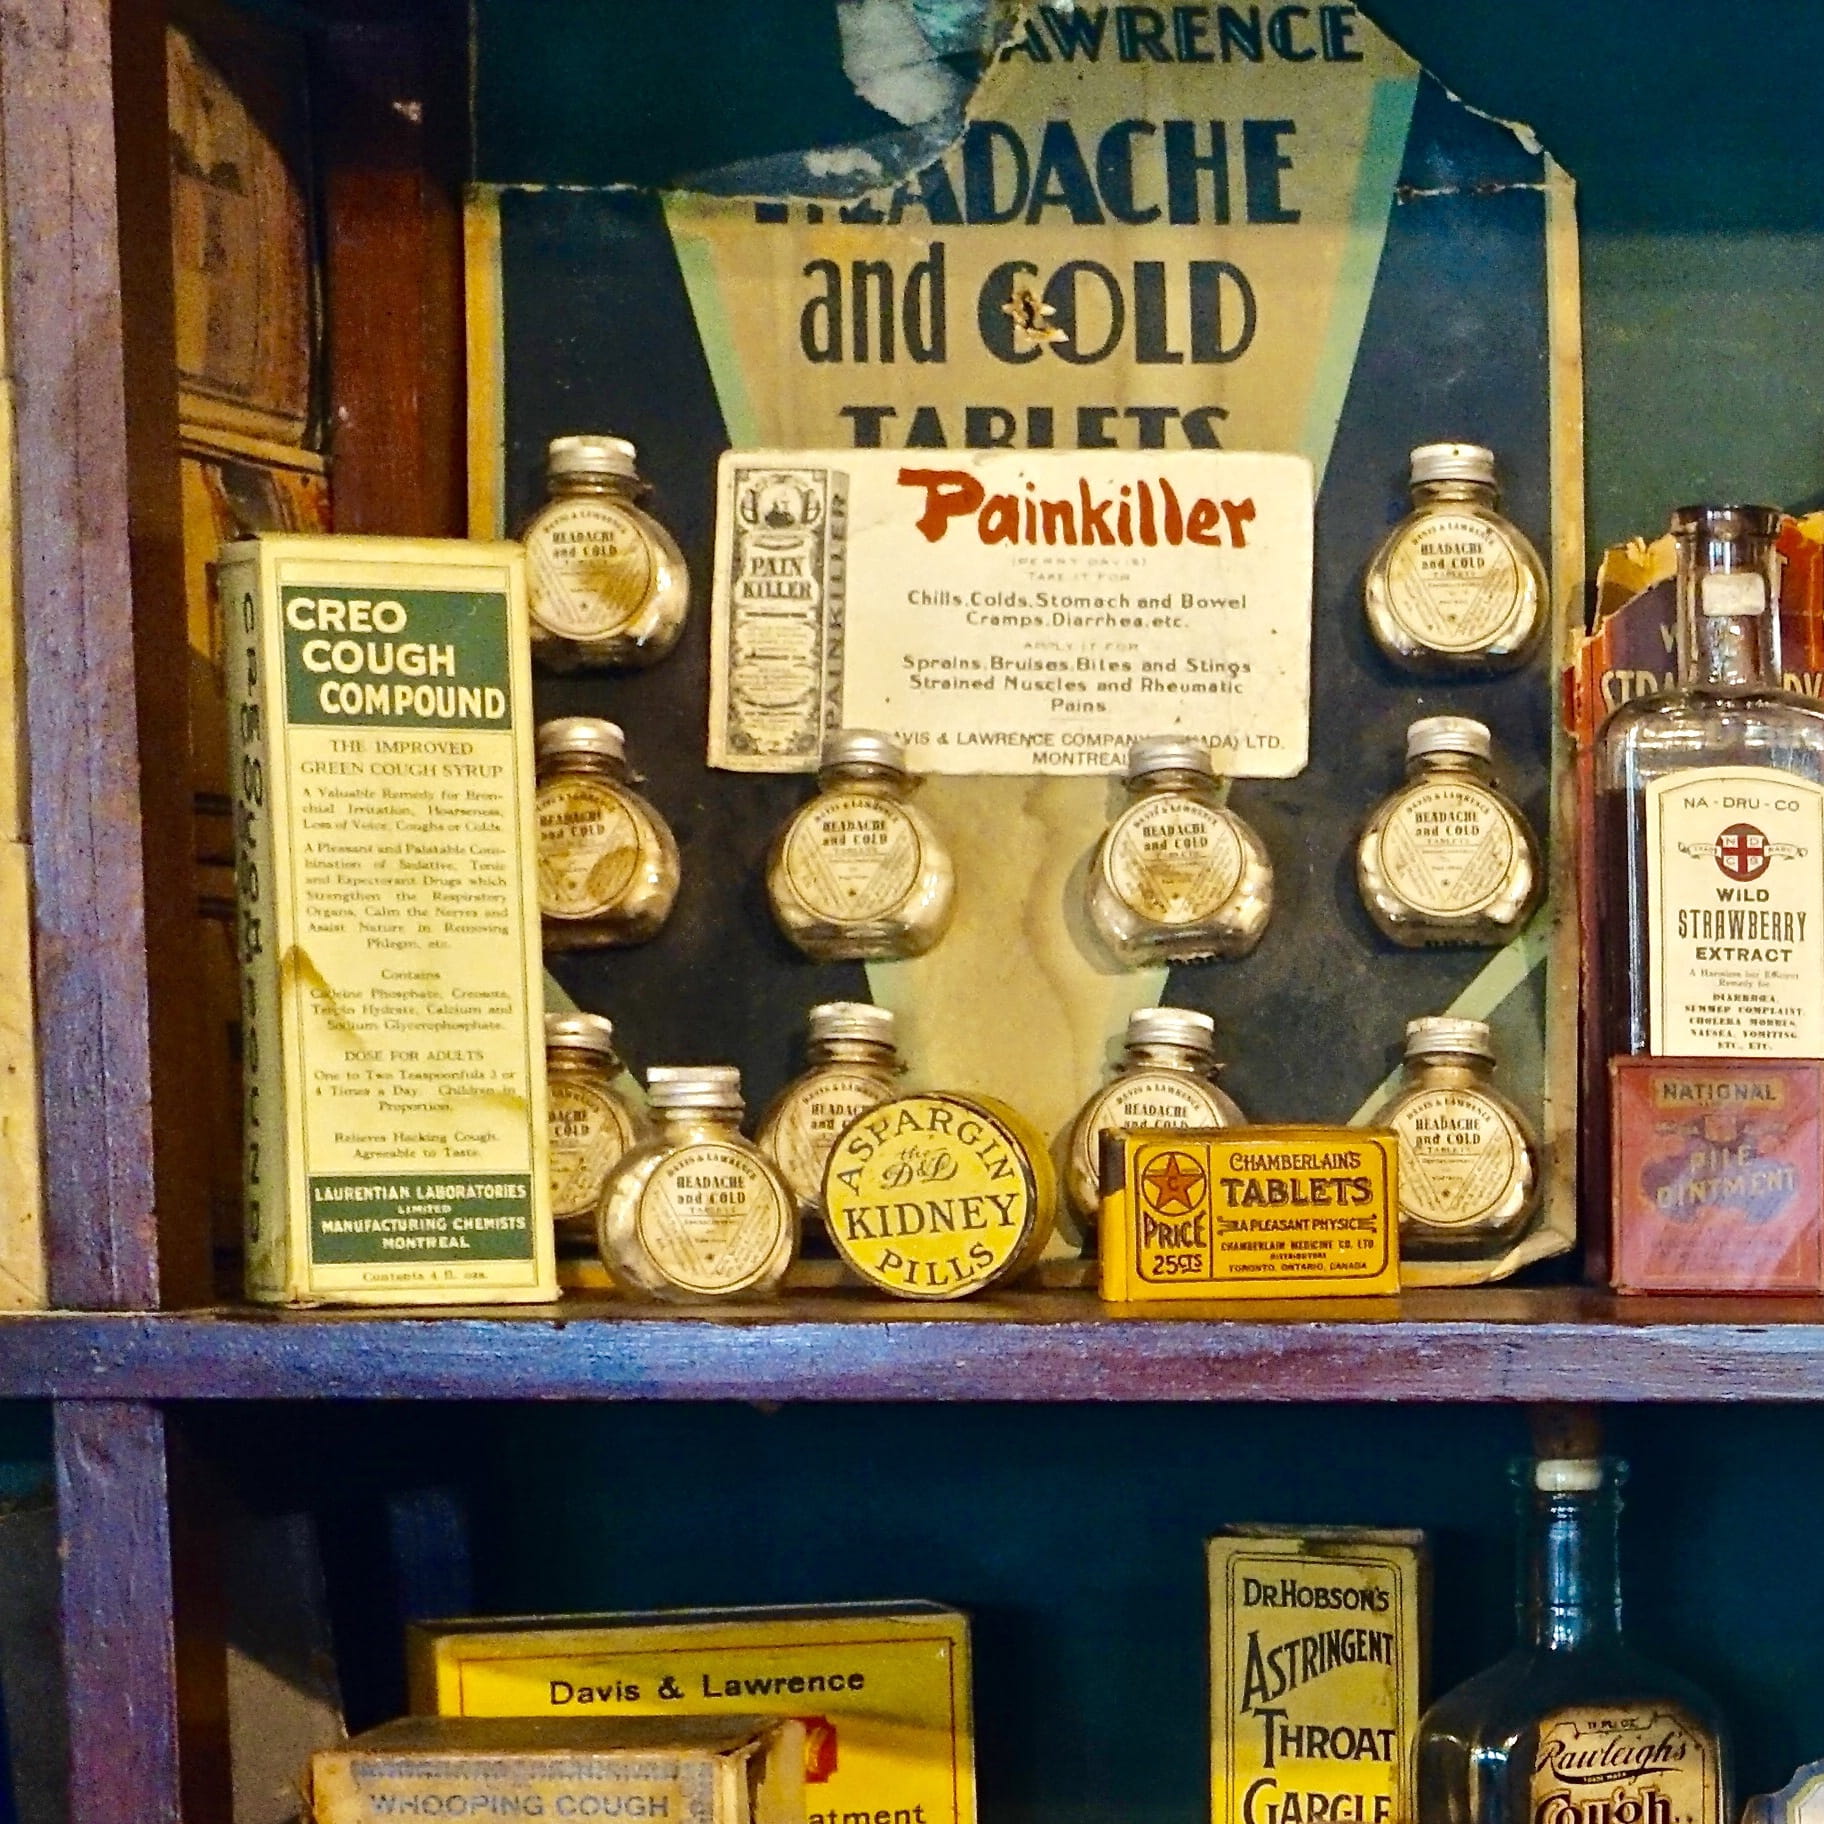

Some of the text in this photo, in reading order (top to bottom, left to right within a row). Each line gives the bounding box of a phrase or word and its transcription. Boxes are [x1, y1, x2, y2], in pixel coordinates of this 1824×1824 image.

[800, 242, 1258, 365] and COLD
[898, 467, 1257, 550] Painkiller
[286, 597, 407, 635] CREO
[302, 640, 456, 678] COUGH
[320, 681, 506, 719] COMPOUND
[1097, 677, 1134, 693] and
[301, 761, 504, 779] GREEN COUGH SYRUP
[1715, 888, 1770, 904] WILD
[1677, 910, 1808, 944] STRAWBERRY
[1694, 946, 1794, 963] EXTRACT
[1662, 1082, 1779, 1103] NATIONAL
[837, 1107, 1015, 1197] ASPARGIN
[1446, 1133, 1481, 1146] COLD
[315, 1183, 527, 1201] LAURENTIAN LABORATORIES
[1219, 1176, 1374, 1209] TABLETS
[842, 1192, 1021, 1242] KIDNEY
[1142, 1210, 1207, 1251] PRICE
[875, 1242, 996, 1286] PILLS
[550, 1668, 866, 1707] Davis Lawrence
[1241, 1629, 1393, 1713] ASTRINGENT
[1253, 1708, 1396, 1769] THROAT
[369, 1793, 670, 1819] WHOOPING COUGH
